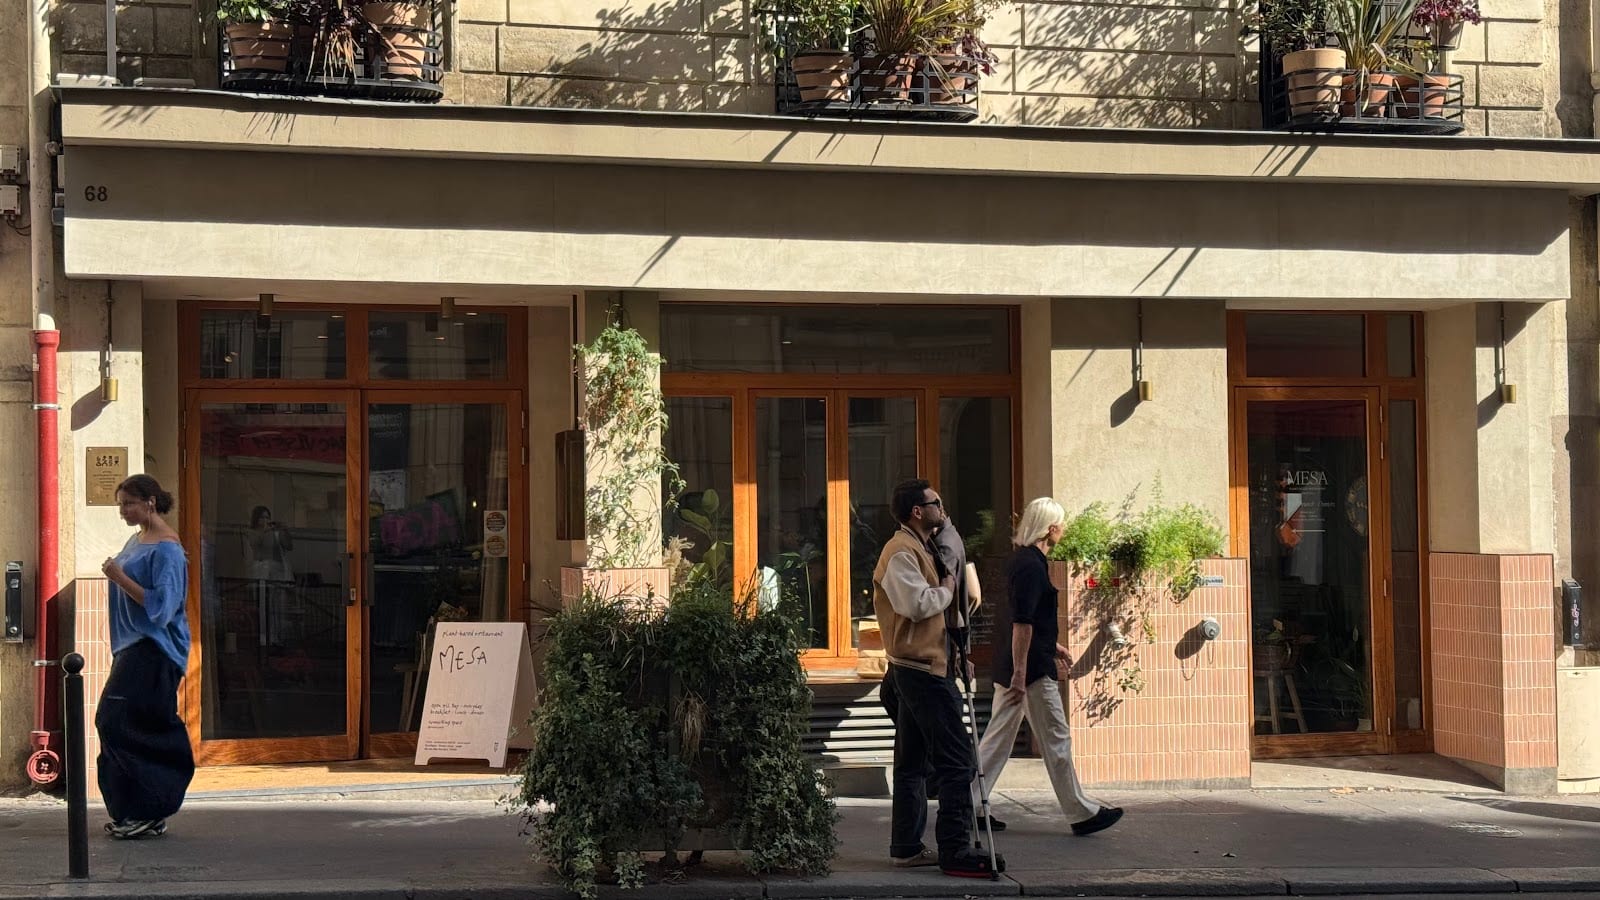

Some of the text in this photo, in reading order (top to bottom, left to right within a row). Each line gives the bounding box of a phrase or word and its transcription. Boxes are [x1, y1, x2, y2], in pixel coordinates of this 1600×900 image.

[84, 185, 108, 202] 68
[1286, 470, 1329, 486] MESA
[439, 644, 488, 673] MESA
